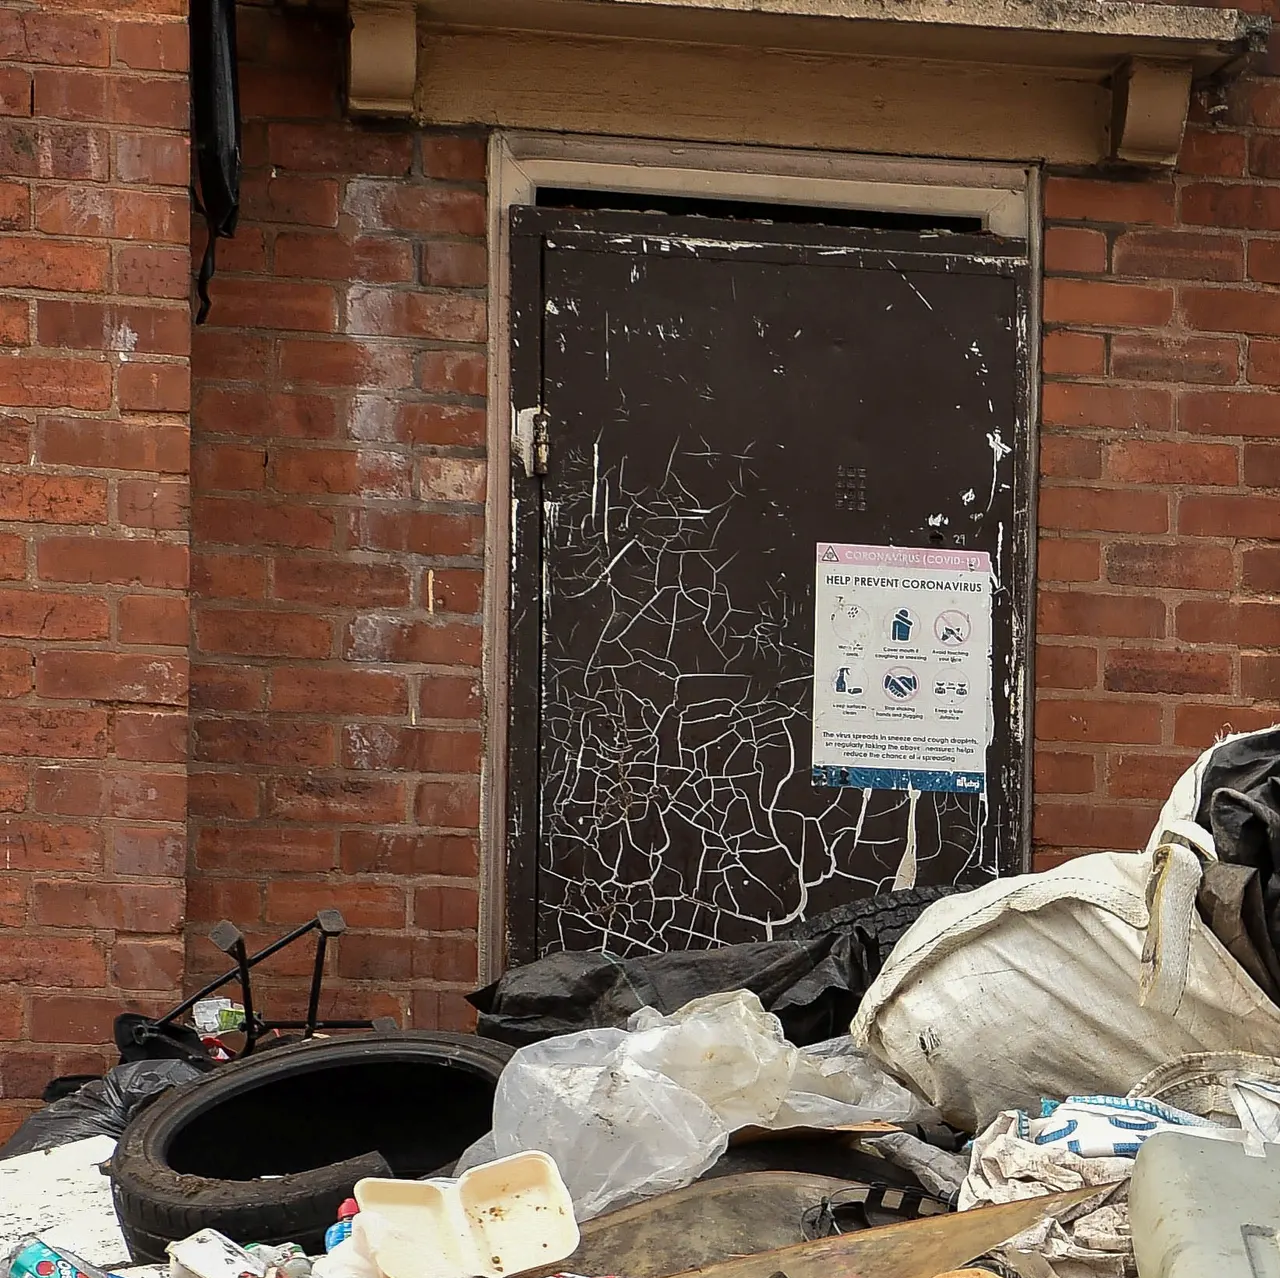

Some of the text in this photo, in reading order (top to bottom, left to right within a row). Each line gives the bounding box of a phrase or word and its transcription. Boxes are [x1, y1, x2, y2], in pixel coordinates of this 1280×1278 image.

[845, 551, 920, 564] CORONAVIRUS
[826, 575, 982, 592] HELP PREVENT CORONAVIRUS
[852, 733, 879, 741] spreads
[927, 737, 949, 745] cough
[834, 741, 863, 750] regularly
[865, 742, 886, 751] taking
[956, 746, 974, 754] helps
[843, 750, 868, 758] reduce
[881, 752, 907, 760] chance
[922, 754, 956, 763] spreading
